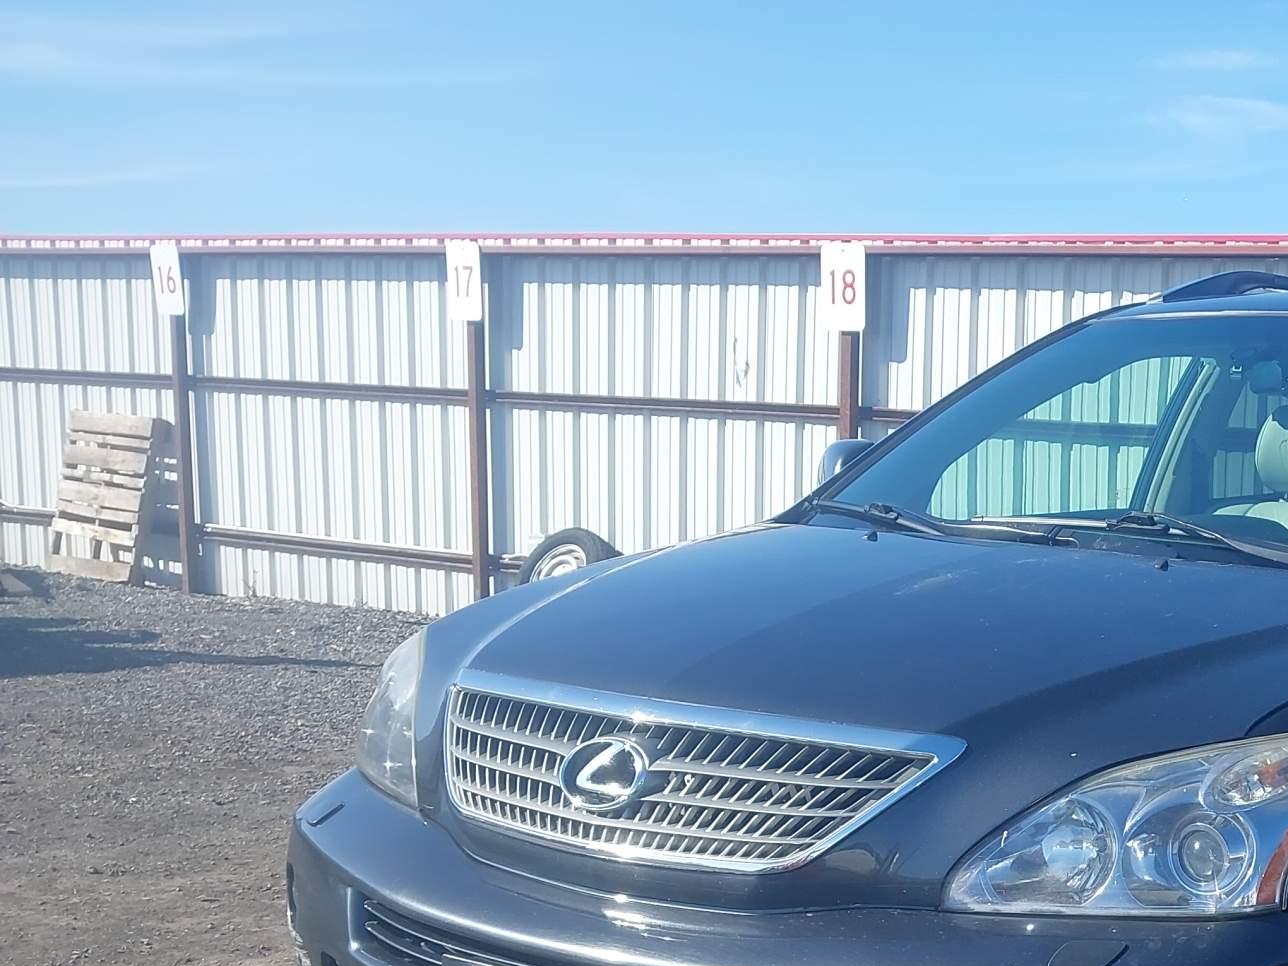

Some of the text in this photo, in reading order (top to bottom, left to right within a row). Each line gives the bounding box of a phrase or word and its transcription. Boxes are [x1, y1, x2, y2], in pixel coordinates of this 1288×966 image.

[158, 265, 176, 294] 16
[454, 265, 473, 298] 17
[829, 268, 857, 305] 18
